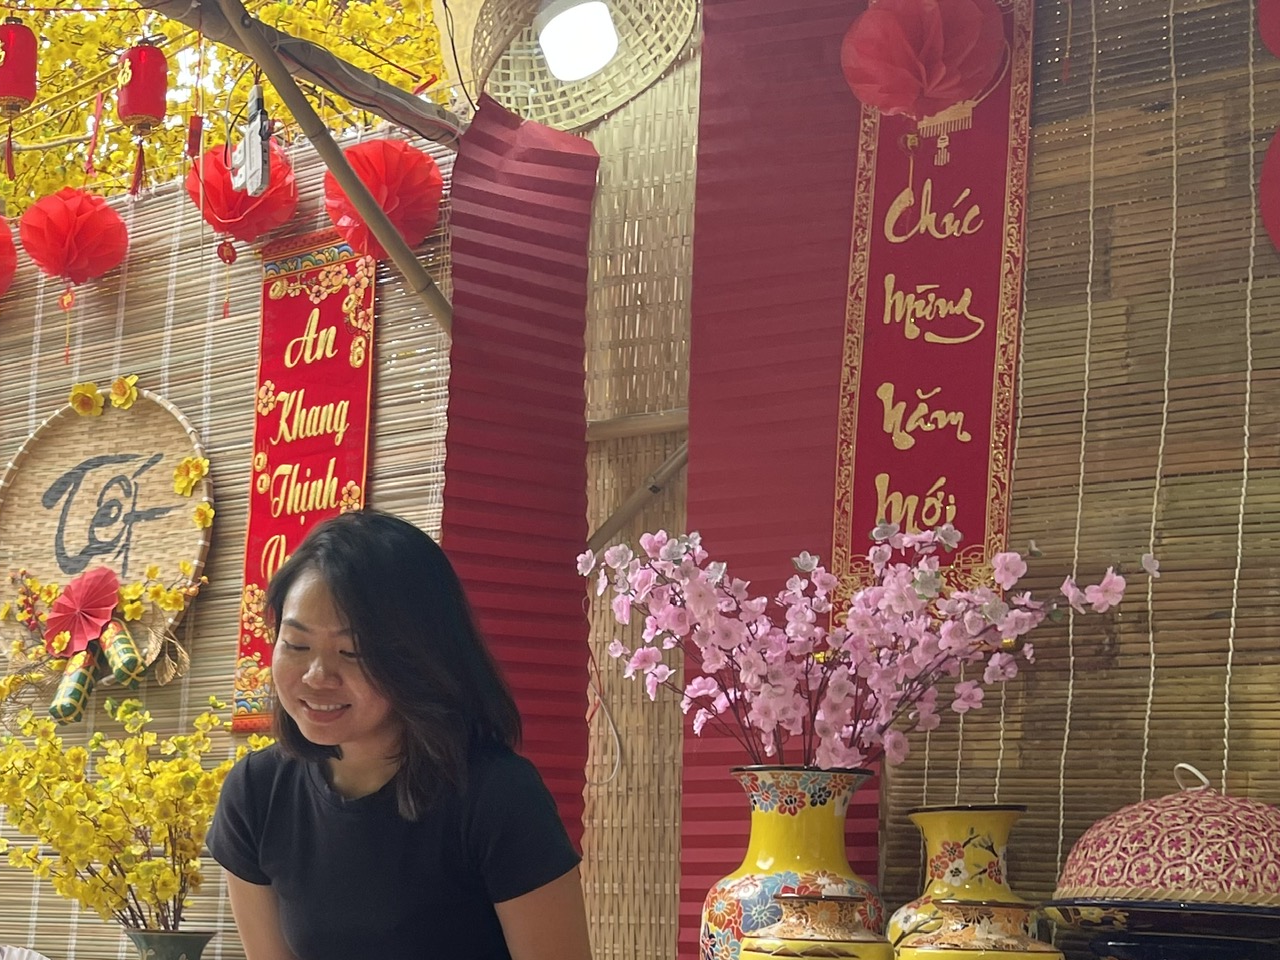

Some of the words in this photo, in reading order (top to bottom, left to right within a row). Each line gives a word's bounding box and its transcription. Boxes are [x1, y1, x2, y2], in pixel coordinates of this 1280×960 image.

[884, 178, 984, 244] Chúc
[284, 307, 339, 369] An
[269, 388, 351, 447] Khang
[42, 452, 187, 579] Tết
[270, 457, 340, 526] Thịnh
